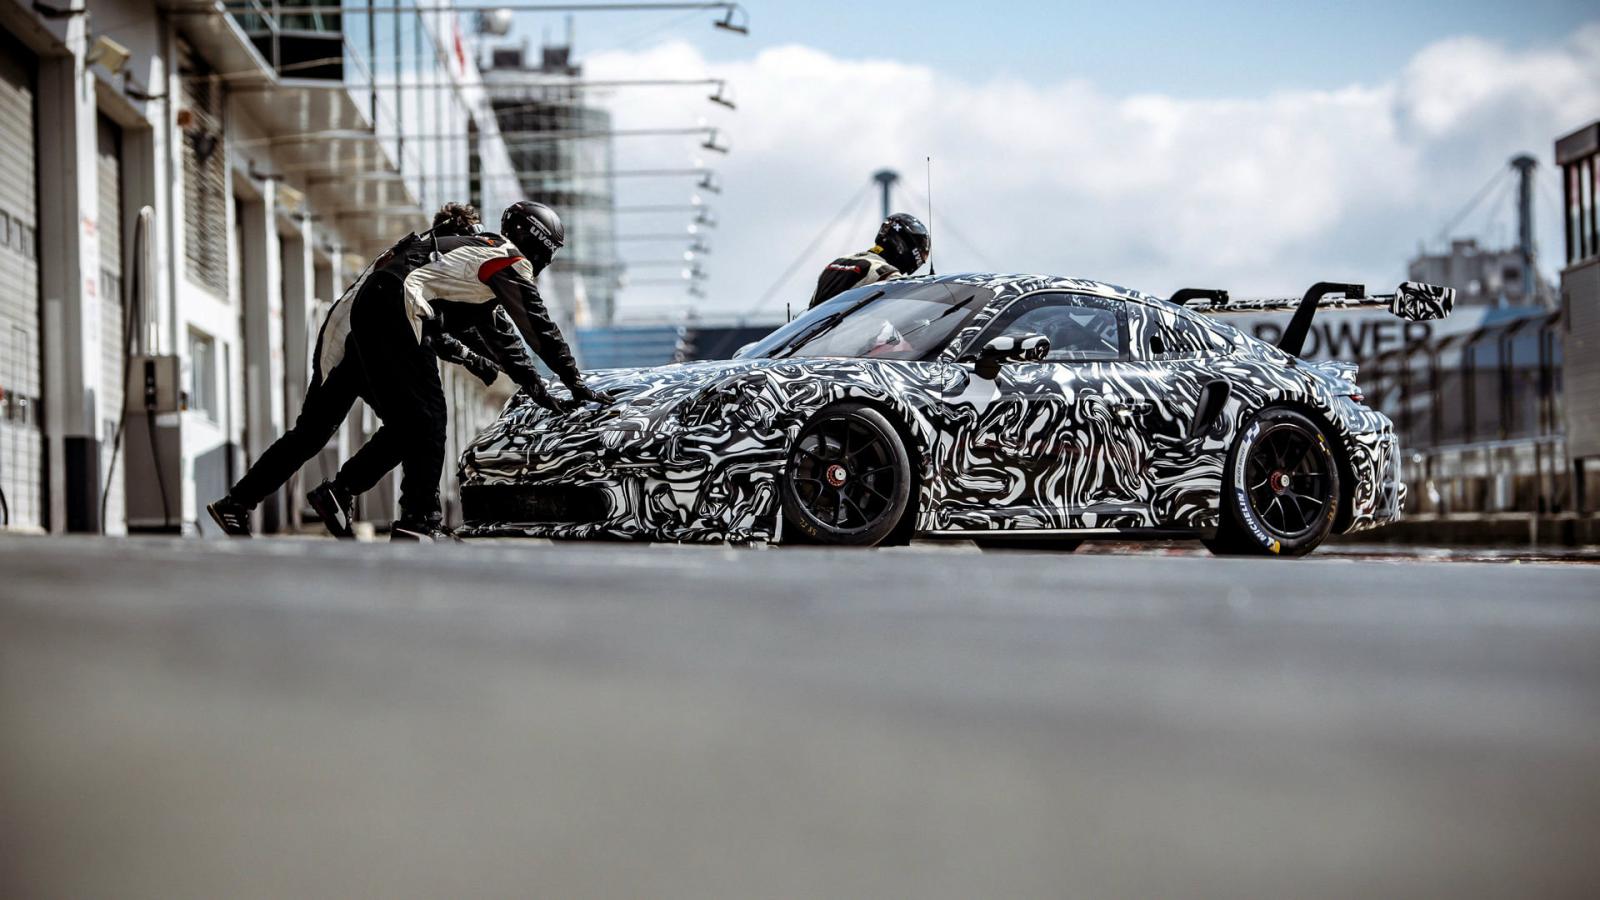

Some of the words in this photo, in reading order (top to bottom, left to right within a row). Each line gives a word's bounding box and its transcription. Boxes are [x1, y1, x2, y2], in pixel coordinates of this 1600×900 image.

[530, 226, 557, 252] uvex
[912, 247, 922, 267] uve
[1237, 493, 1267, 541] MICHELIN
